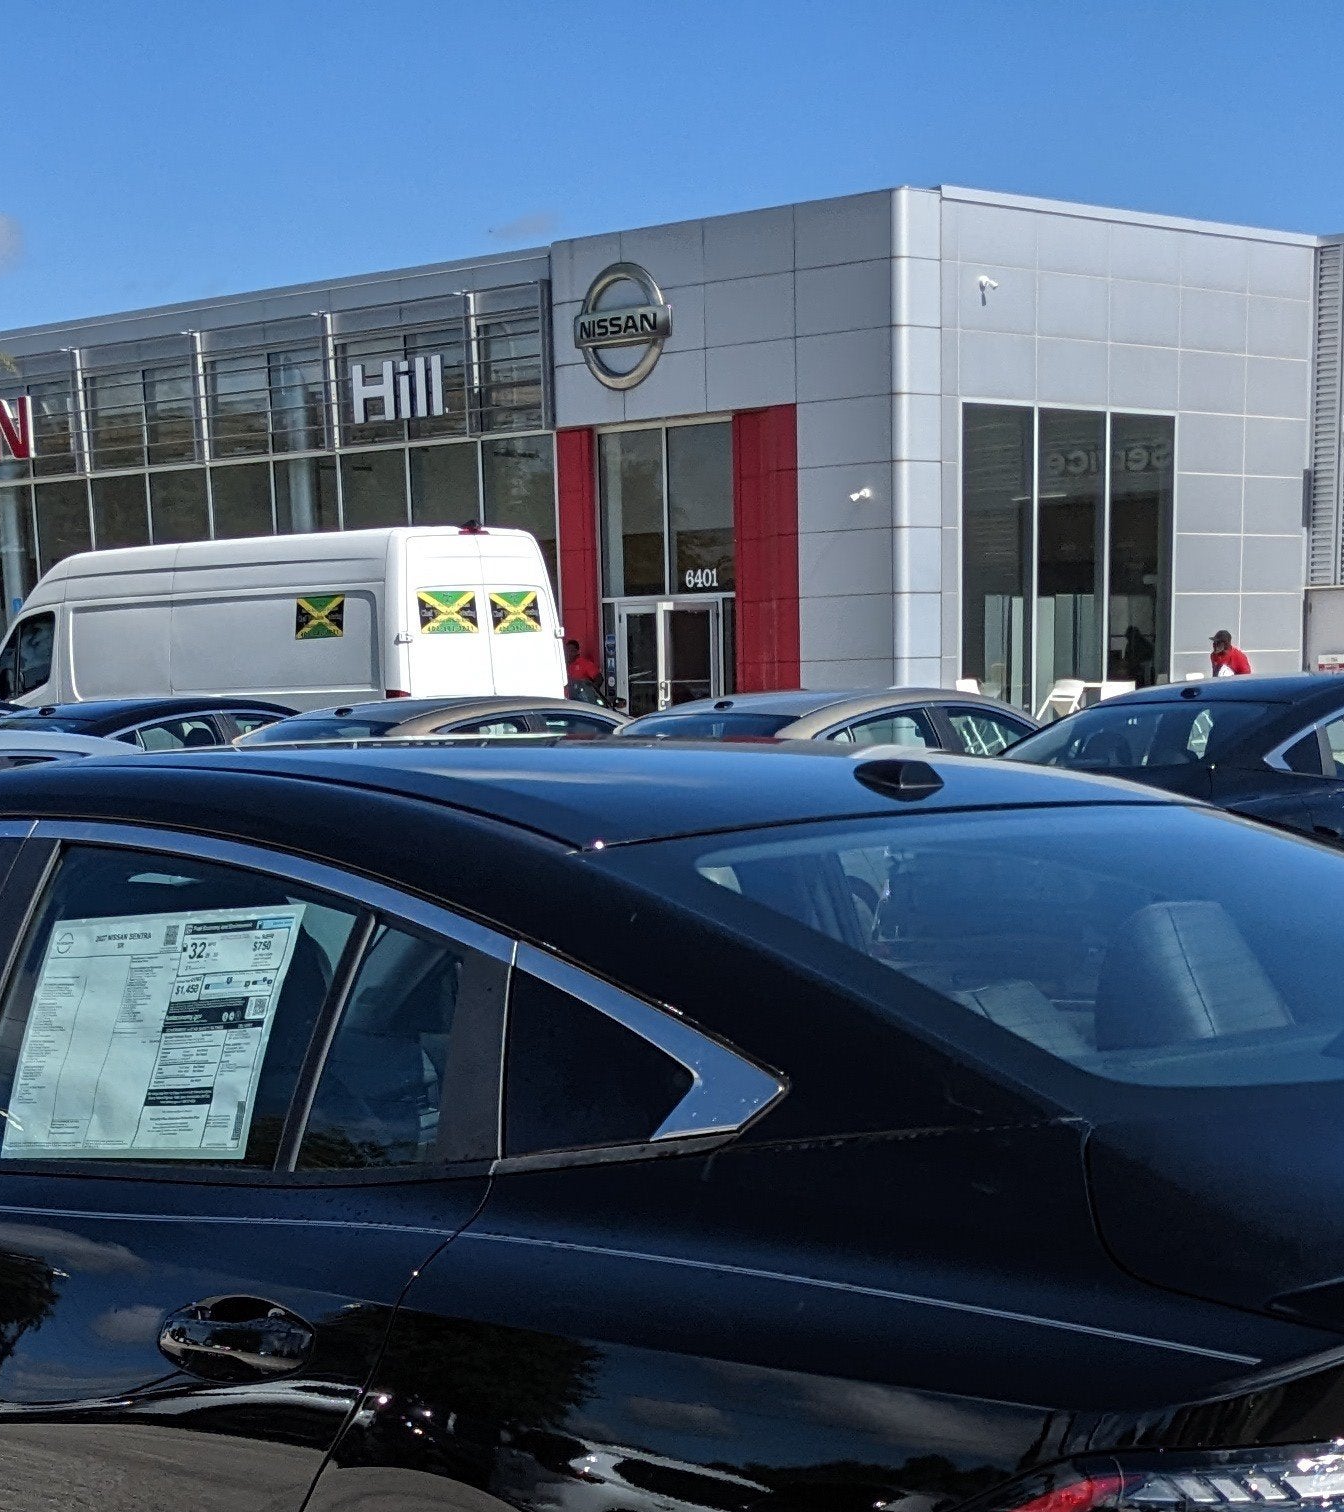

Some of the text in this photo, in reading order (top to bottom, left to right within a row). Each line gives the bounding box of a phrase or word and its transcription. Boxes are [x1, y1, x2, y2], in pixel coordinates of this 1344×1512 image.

[579, 312, 658, 339] NISSAN
[686, 568, 718, 588] 6401
[189, 942, 206, 959] 32
